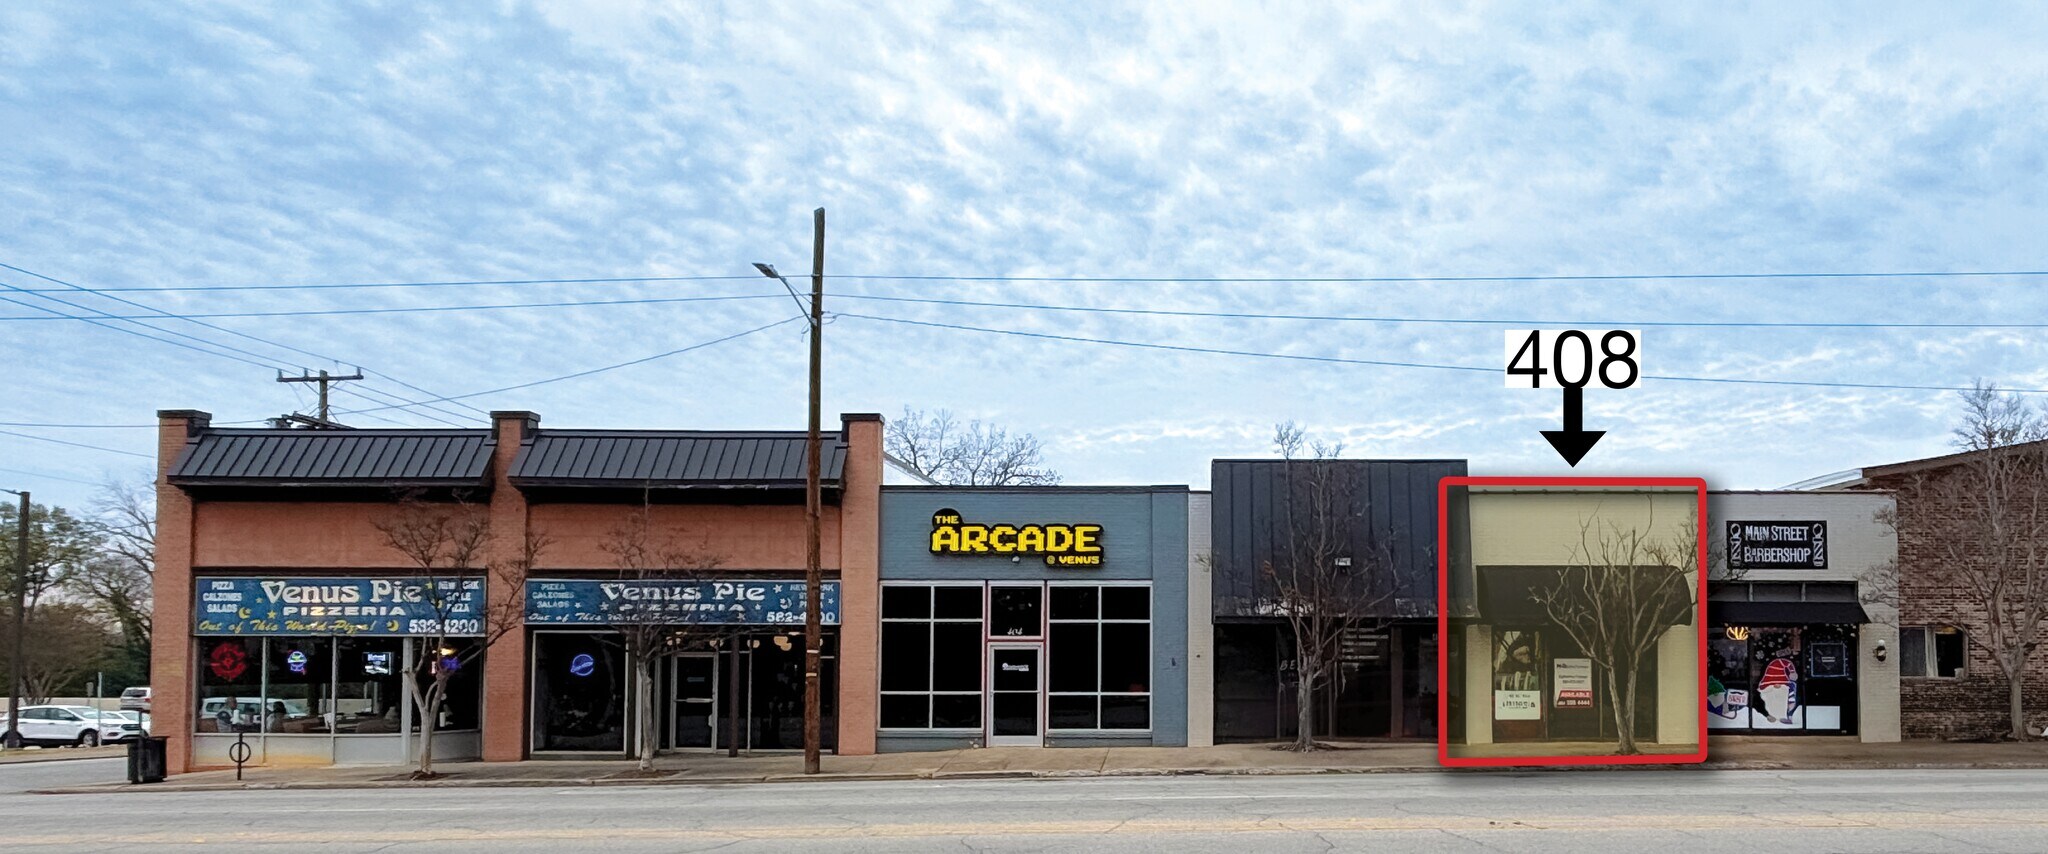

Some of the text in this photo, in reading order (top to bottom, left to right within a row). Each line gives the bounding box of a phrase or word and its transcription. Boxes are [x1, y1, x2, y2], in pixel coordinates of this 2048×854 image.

[934, 515, 959, 524] THE
[1745, 525, 1809, 541] MAIN STREET
[932, 526, 1101, 552] ARCADE
[1058, 556, 1100, 564] VENUS
[1744, 546, 1811, 563] BARBERSHOP
[212, 581, 234, 590] PIZZA
[203, 592, 242, 601] CALZONES
[260, 579, 422, 604] Venus Pie
[532, 591, 575, 599] CALZONES
[600, 582, 765, 601] Venus Pie
[207, 604, 238, 613] SALADS
[283, 606, 406, 616] PIZZERIA
[528, 613, 551, 621] Out
[556, 613, 569, 623] of
[574, 612, 601, 621] This
[766, 611, 835, 622] 582-400
[199, 620, 222, 631] Out
[228, 621, 243, 634] of
[249, 619, 278, 631] This
